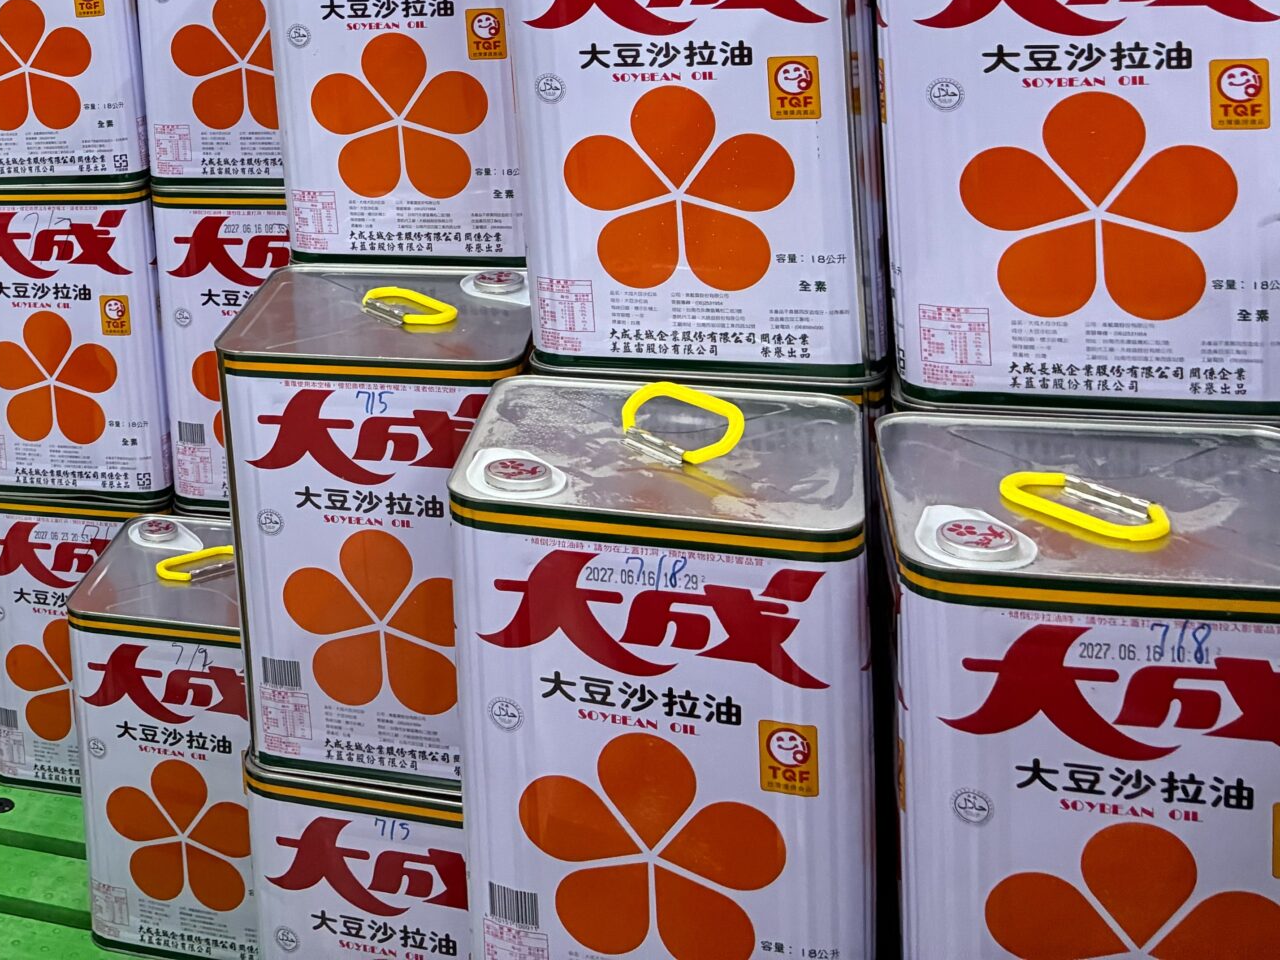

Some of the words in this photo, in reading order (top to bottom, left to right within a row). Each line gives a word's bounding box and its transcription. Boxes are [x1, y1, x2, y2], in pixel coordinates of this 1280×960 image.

[78, 2, 100, 10] TQF
[346, 21, 400, 30] SOYBEAN
[406, 20, 428, 29] OIL
[472, 41, 501, 50] TQF
[579, 40, 753, 69] 大豆沙拉油
[981, 41, 1193, 73] 大豆沙拉油
[612, 71, 682, 82] SOYBEAN
[691, 71, 718, 81] OIL
[1021, 76, 1106, 88] SOYBEAN
[1118, 75, 1149, 86] OIL
[776, 96, 813, 108] TQF
[1219, 103, 1263, 117] TQF
[97, 119, 114, 128] 全素
[493, 189, 514, 199] 全素
[798, 280, 827, 292] 全素
[106, 320, 127, 328] TQF
[1237, 309, 1269, 322] 全素
[245, 389, 488, 485] 大成
[295, 486, 444, 518] 大豆沙拉油
[323, 514, 383, 527] SOYBEAN
[391, 519, 414, 528] OIL
[476, 549, 831, 689] 大成
[540, 671, 742, 726] 大豆沙拉油
[937, 624, 1280, 761] 大成
[578, 708, 658, 730] SOYBEAN
[669, 722, 701, 736] OIL
[116, 720, 232, 755] 大豆沙拉油
[767, 765, 811, 784] TQF
[1015, 758, 1254, 810] 大豆沙拉油
[1059, 798, 1155, 818] SOYBEAN
[1169, 809, 1203, 823] OIL
[310, 910, 457, 956] 大豆沙拉油
[339, 940, 397, 957] SOYBEAN
